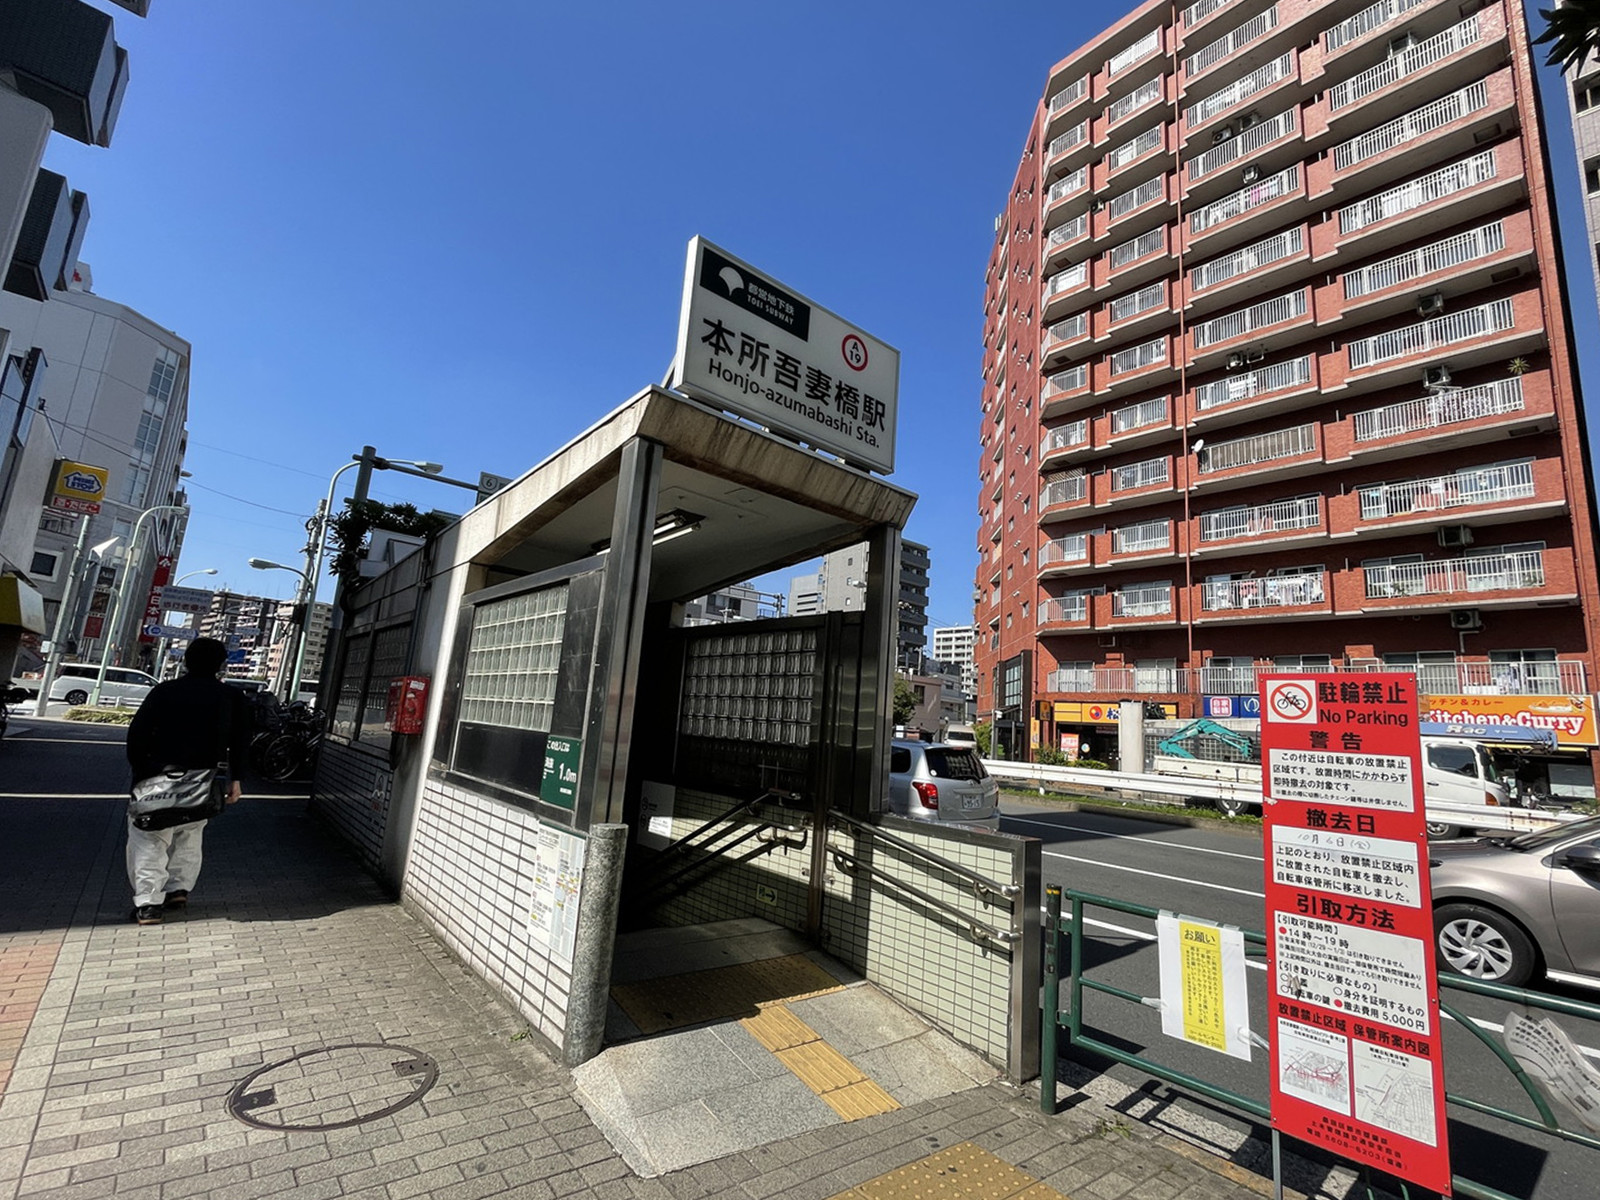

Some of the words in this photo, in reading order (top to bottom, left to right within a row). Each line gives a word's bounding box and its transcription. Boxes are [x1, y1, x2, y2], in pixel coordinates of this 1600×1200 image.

[747, 294, 765, 309] TOEI
[766, 304, 794, 326] SUBWAY
[749, 283, 795, 316] 都営地下鉄
[849, 349, 862, 365] 19
[851, 341, 860, 353] A
[701, 318, 886, 432] 本所吾妻橋駅
[708, 358, 853, 437] Honjo-azumabashi
[856, 425, 880, 449] Sta.
[1318, 682, 1408, 704] 駐輪禁止
[1429, 698, 1504, 706] ッチン&カレー
[1320, 709, 1342, 724] No
[1346, 710, 1409, 727] Parking
[1309, 730, 1362, 751] 警告
[559, 763, 577, 783] 1.0m
[1281, 752, 1407, 770] この付近は自転車の放置禁止
[1273, 764, 1408, 783] 区域です。放置時間にかかわらず
[1273, 777, 1356, 792] 即時撤去の対象です。
[1306, 808, 1376, 834] 撤去日
[1276, 845, 1415, 875] 上記のとおり、放置禁止区域内
[1276, 858, 1409, 888] に放置された自転車を撤去し、
[1277, 871, 1410, 903] 自転車保管所に移送しました。
[1296, 893, 1396, 930] 引取方法
[1184, 929, 1216, 944] お願い
[1277, 914, 1339, 935] 【引取可能時間】
[1278, 960, 1379, 993] 【引き取りに必要なもの】
[1343, 989, 1425, 1018] 身分を証明するもの
[1343, 1001, 1379, 1019] 撤去費用
[1278, 1002, 1347, 1033] 放置禁止区域
[1353, 1023, 1430, 1057] 保管所案内図
